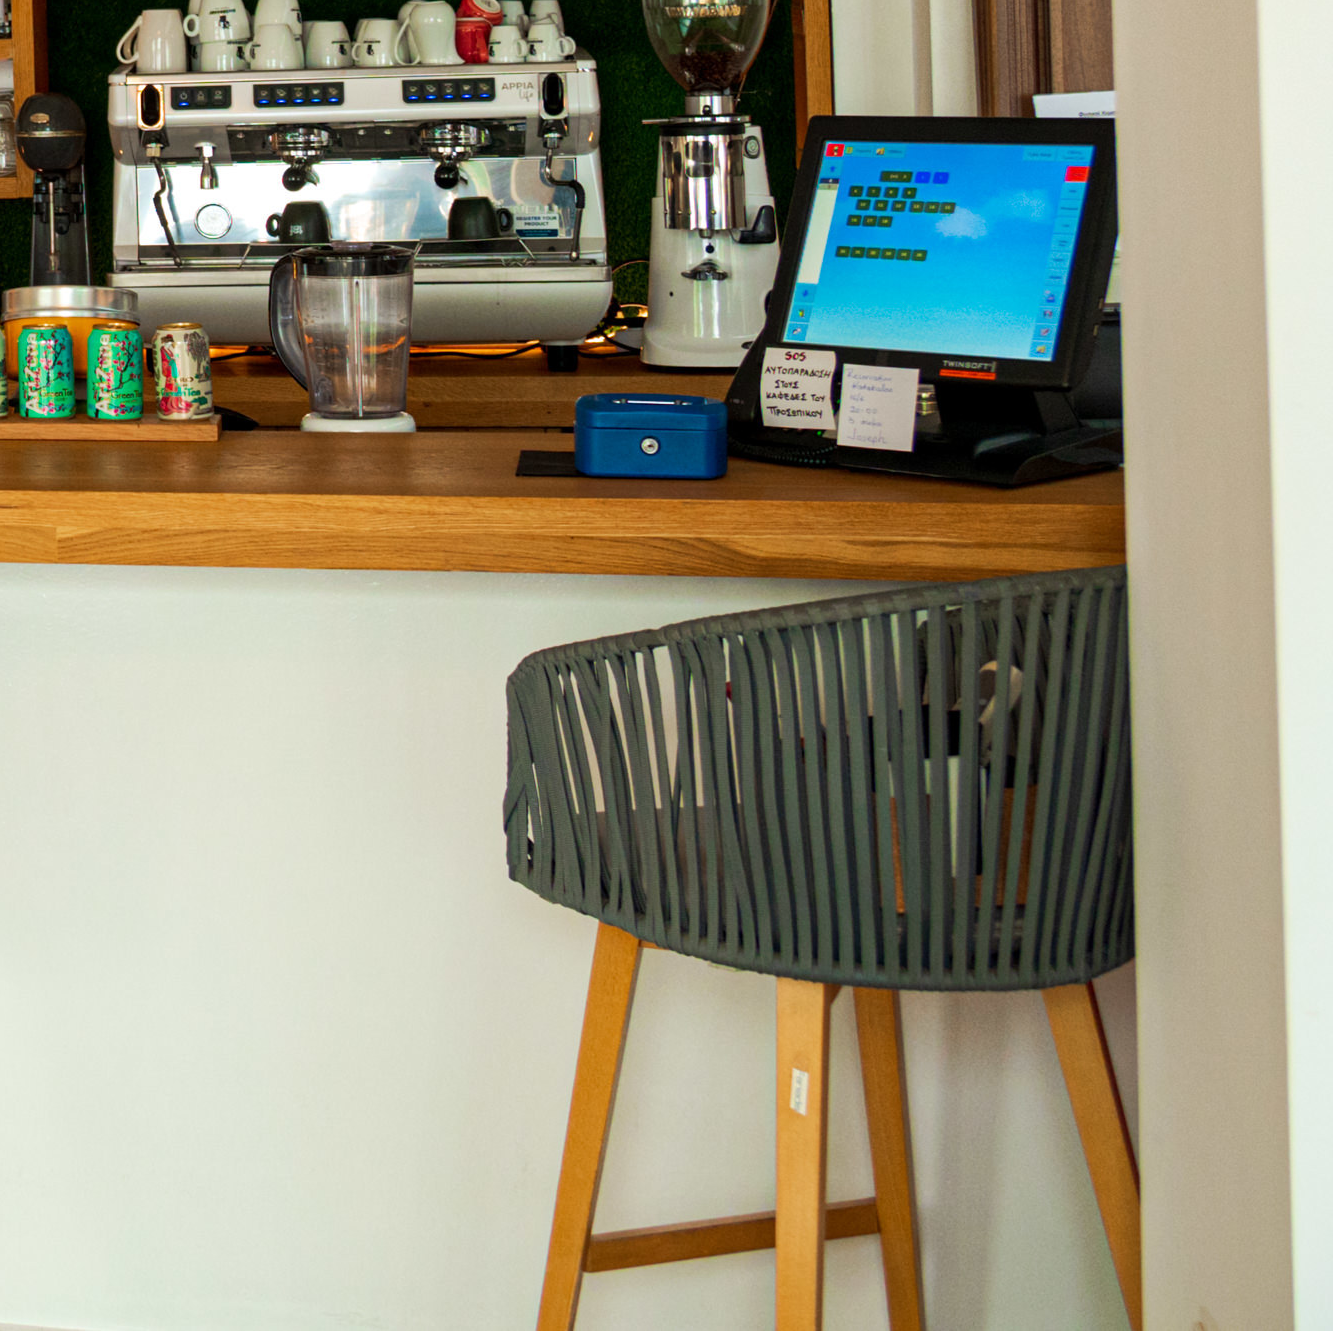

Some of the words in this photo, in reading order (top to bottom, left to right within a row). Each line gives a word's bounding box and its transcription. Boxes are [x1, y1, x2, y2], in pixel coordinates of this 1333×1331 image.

[501, 82, 535, 91] APPIA
[785, 351, 807, 362] SOS
[943, 360, 989, 370] TWINSOFT
[110, 389, 134, 399] Green
[186, 387, 202, 397] Tea
